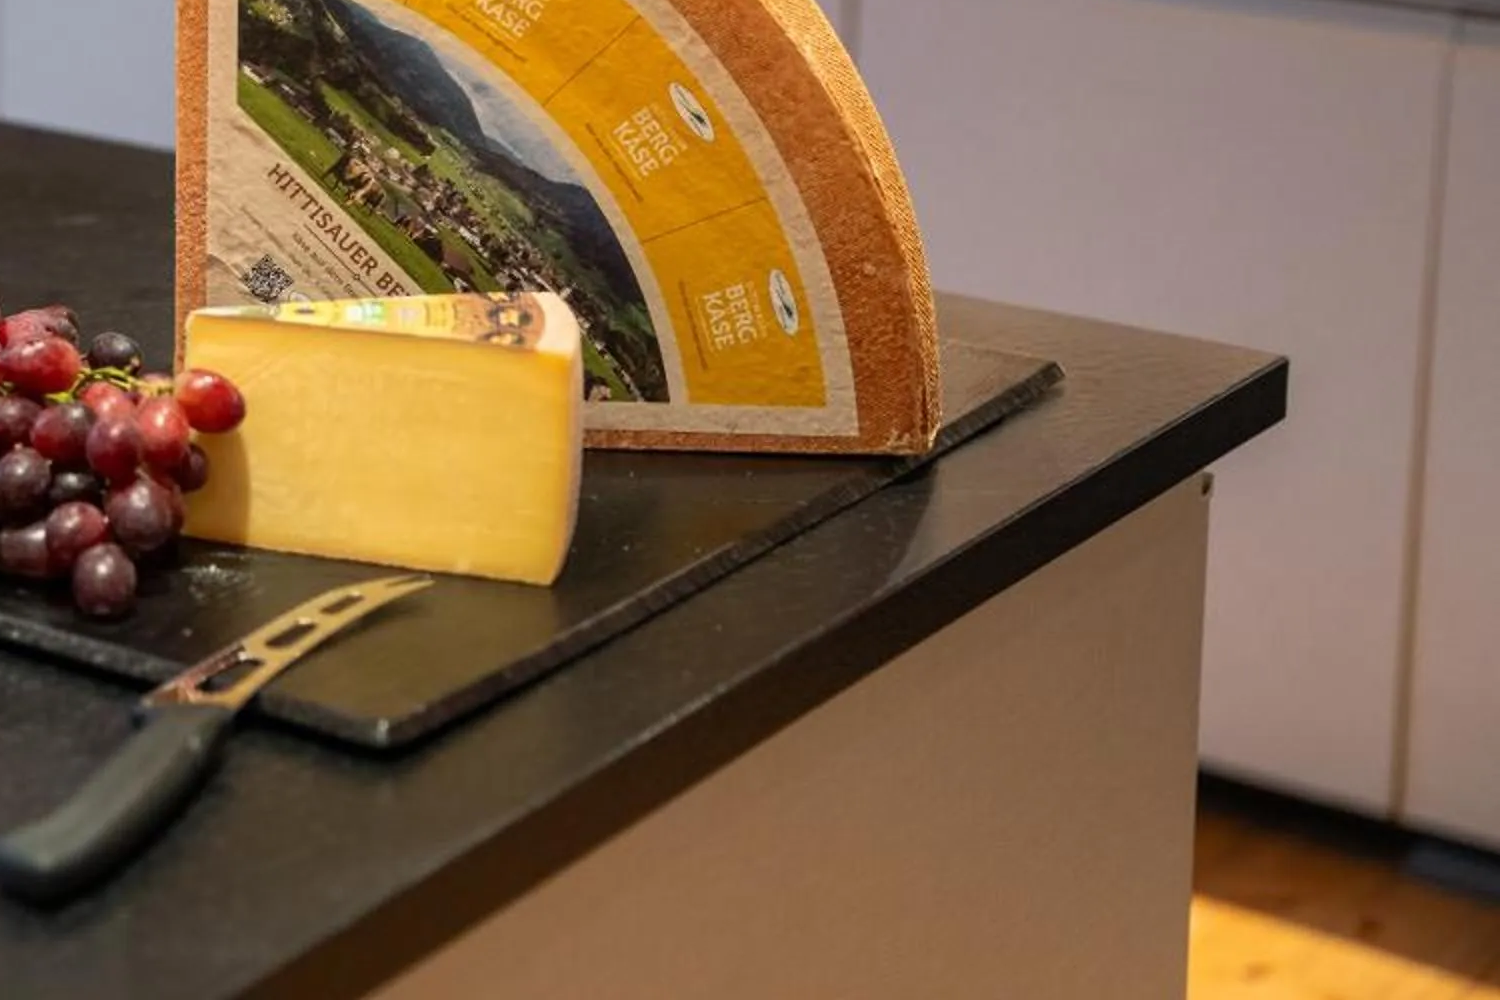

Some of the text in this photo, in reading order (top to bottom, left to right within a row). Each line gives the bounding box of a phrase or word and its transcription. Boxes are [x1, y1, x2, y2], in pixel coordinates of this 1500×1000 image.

[631, 105, 679, 166] BERG
[267, 163, 379, 277] HITTISAUER
[375, 271, 411, 297] BE
[725, 283, 758, 344] BERG
